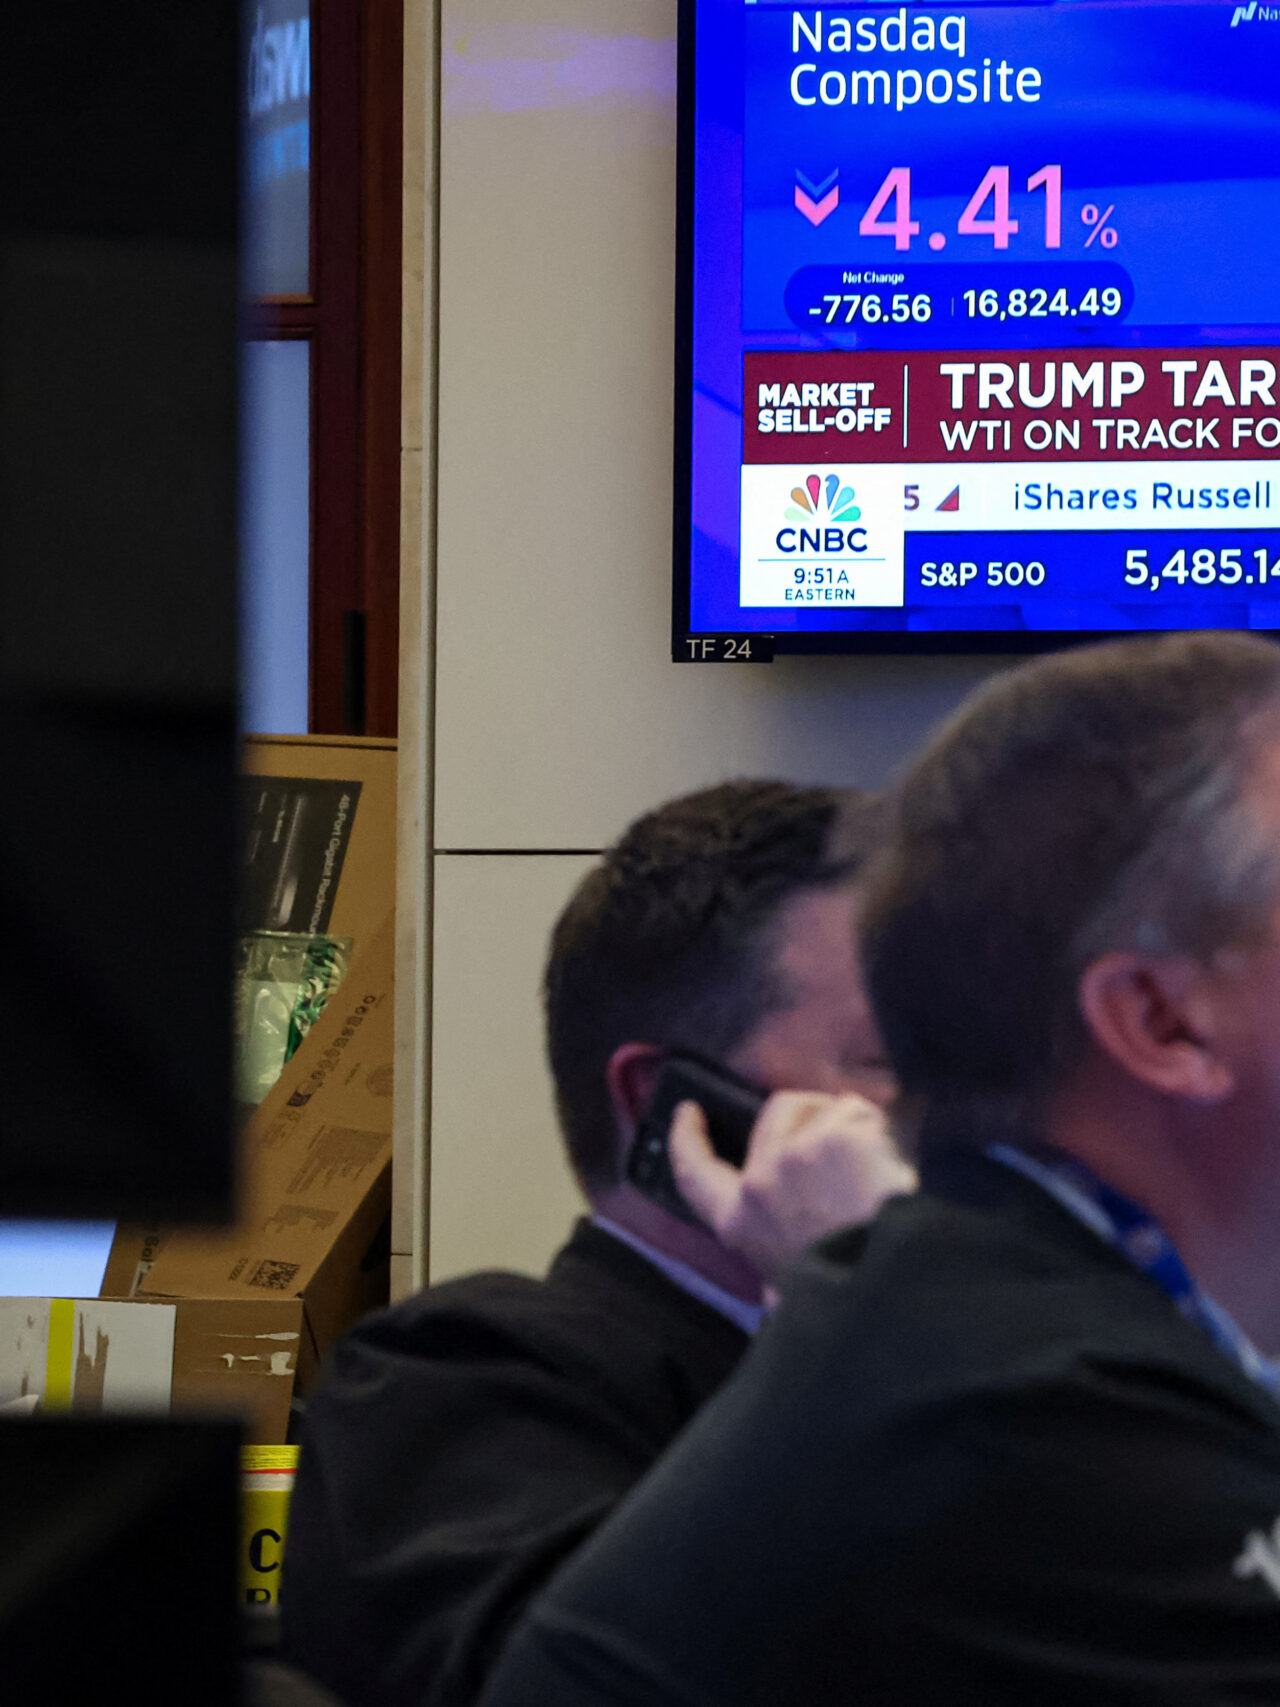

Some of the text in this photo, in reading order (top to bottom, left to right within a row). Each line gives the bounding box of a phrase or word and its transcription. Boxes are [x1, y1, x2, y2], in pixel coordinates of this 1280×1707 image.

[793, 8, 965, 57] Nasdaq
[791, 60, 1041, 111] Composite
[843, 272, 904, 284] Net Change
[809, 294, 931, 323] -776.56
[963, 288, 1121, 321] 16,824.49
[759, 383, 874, 407] MARKET
[940, 362, 1144, 408] TRUMP
[758, 408, 891, 432] SELL-OFF
[940, 420, 1010, 450] WTI
[1024, 420, 1079, 449] ON
[1093, 418, 1219, 449] TRACK
[1015, 483, 1137, 510] iShares
[1153, 481, 1269, 509] Russell
[776, 528, 867, 552] CNBC
[921, 563, 977, 586] S&P
[987, 562, 1045, 586] 500
[785, 589, 854, 600] EASTERN
[686, 639, 751, 658] TF 24
